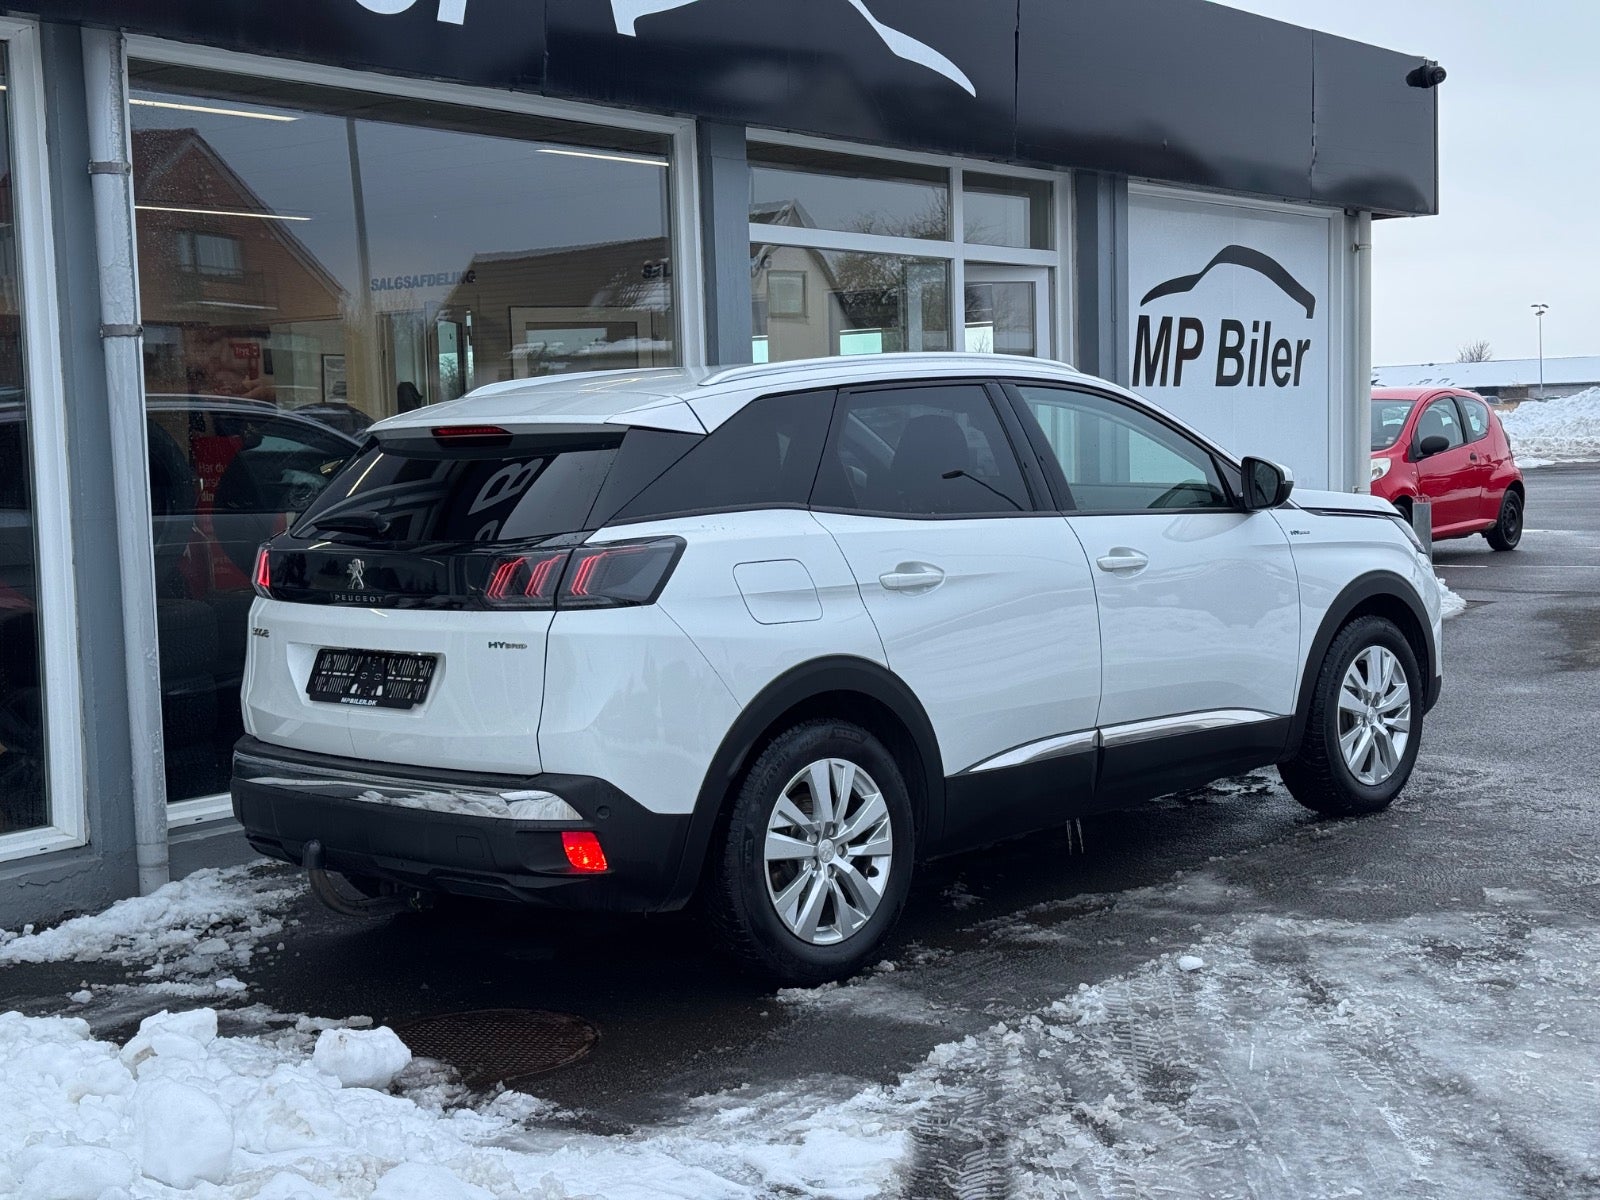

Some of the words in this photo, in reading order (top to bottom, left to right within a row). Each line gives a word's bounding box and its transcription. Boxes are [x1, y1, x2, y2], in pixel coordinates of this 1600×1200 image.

[1132, 315, 1204, 387] MP
[1215, 318, 1311, 388] Biler
[334, 594, 383, 603] PEUGEOT
